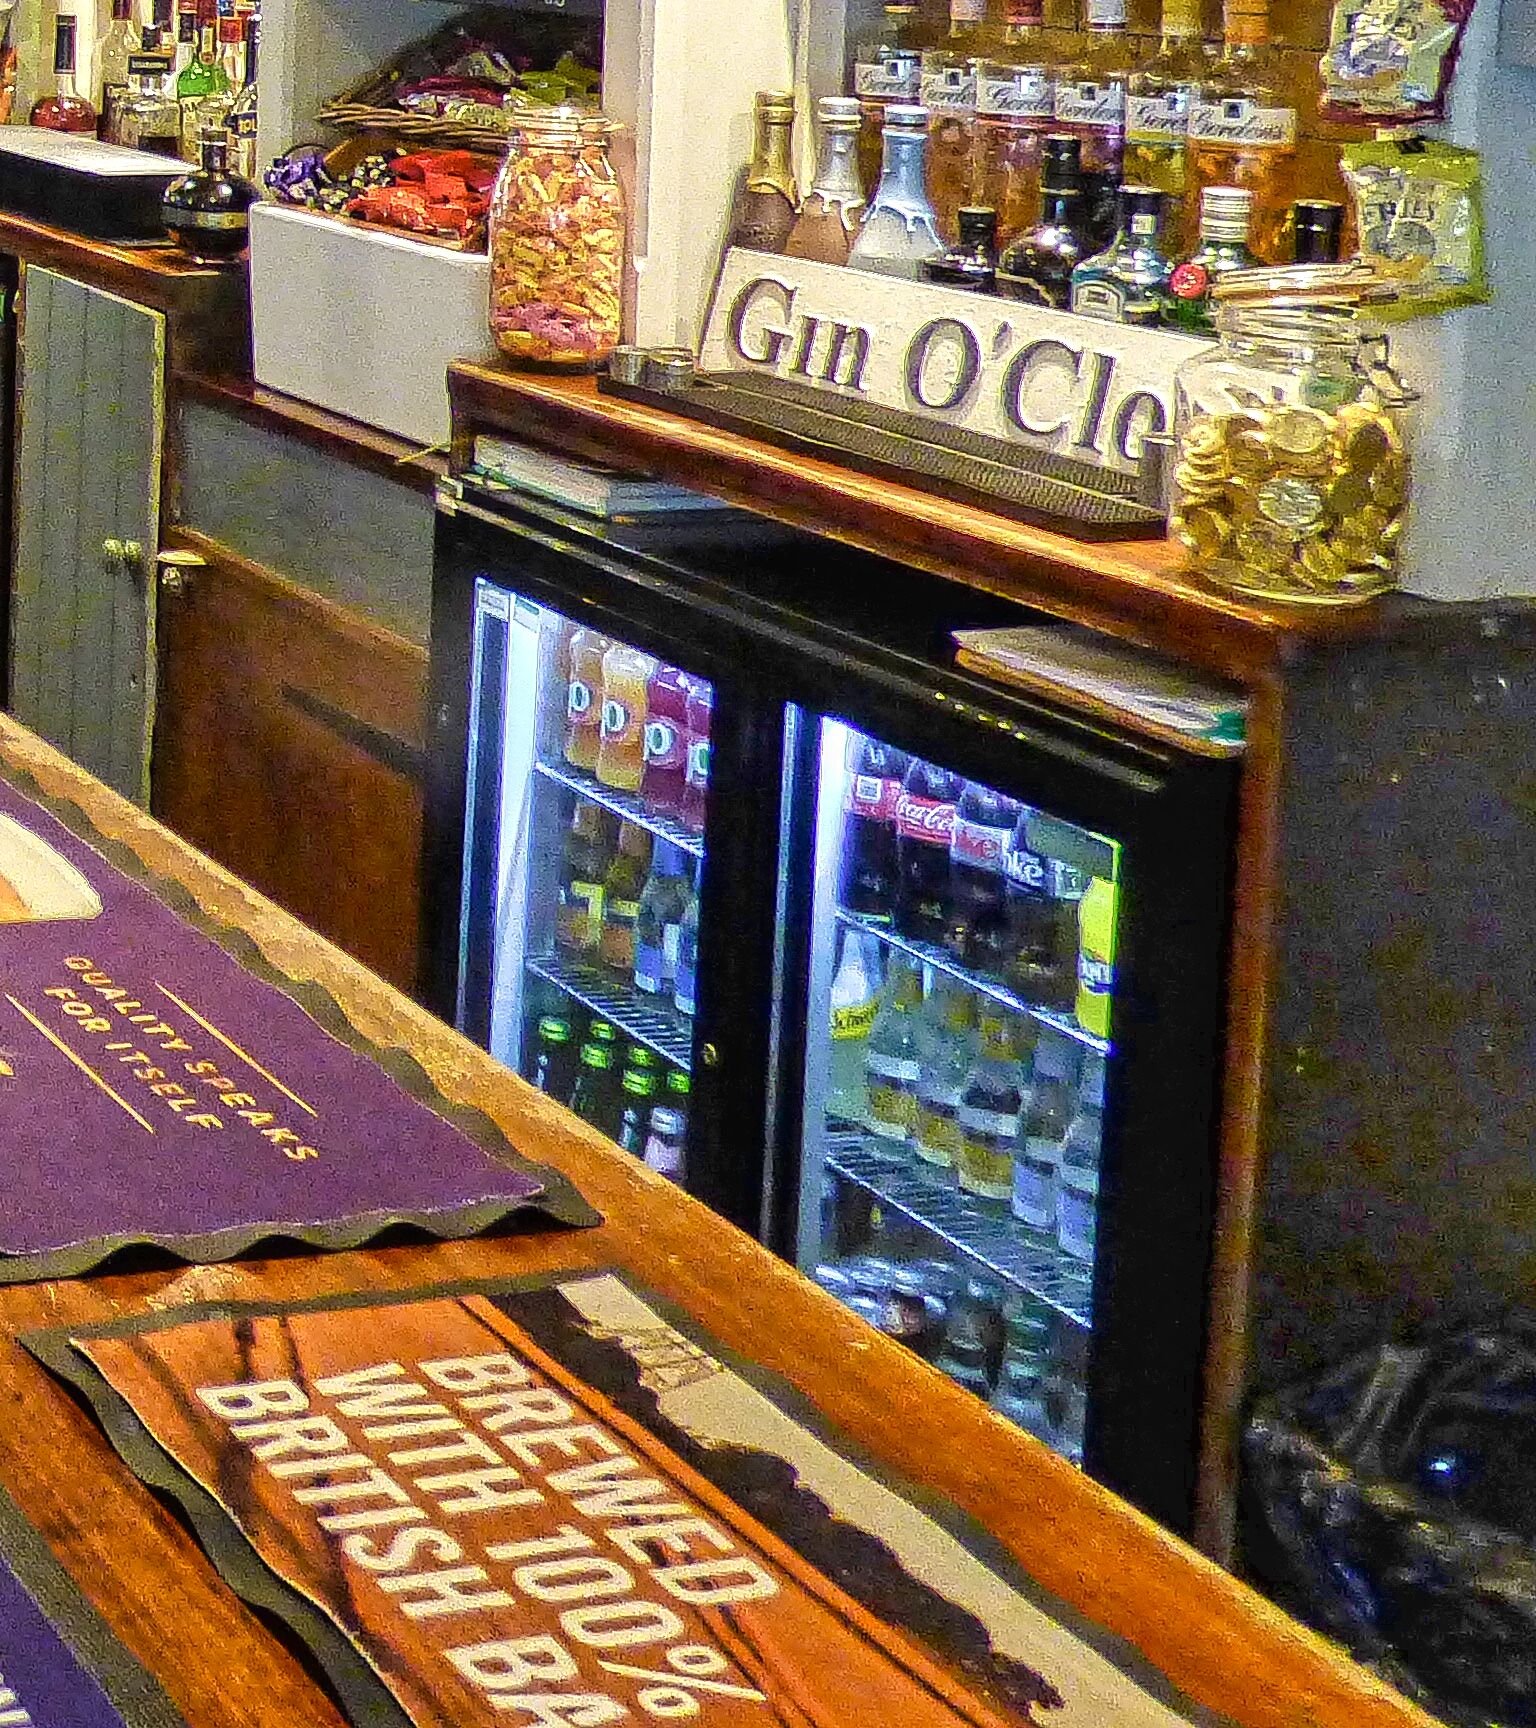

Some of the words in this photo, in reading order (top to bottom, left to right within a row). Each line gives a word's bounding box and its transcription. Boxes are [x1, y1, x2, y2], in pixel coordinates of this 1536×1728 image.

[726, 275, 871, 391] Gin
[904, 317, 1180, 462] O'Clo
[43, 985, 114, 1043] FOR
[105, 1040, 225, 1133] ITSELF
[61, 956, 195, 1070] QUALITY
[188, 1066, 319, 1164] SPEAKS
[197, 1378, 513, 1621] BRITISH
[313, 1360, 546, 1515] WITH
[488, 1523, 768, 1720] 100%
[417, 1350, 780, 1605] BREWED
